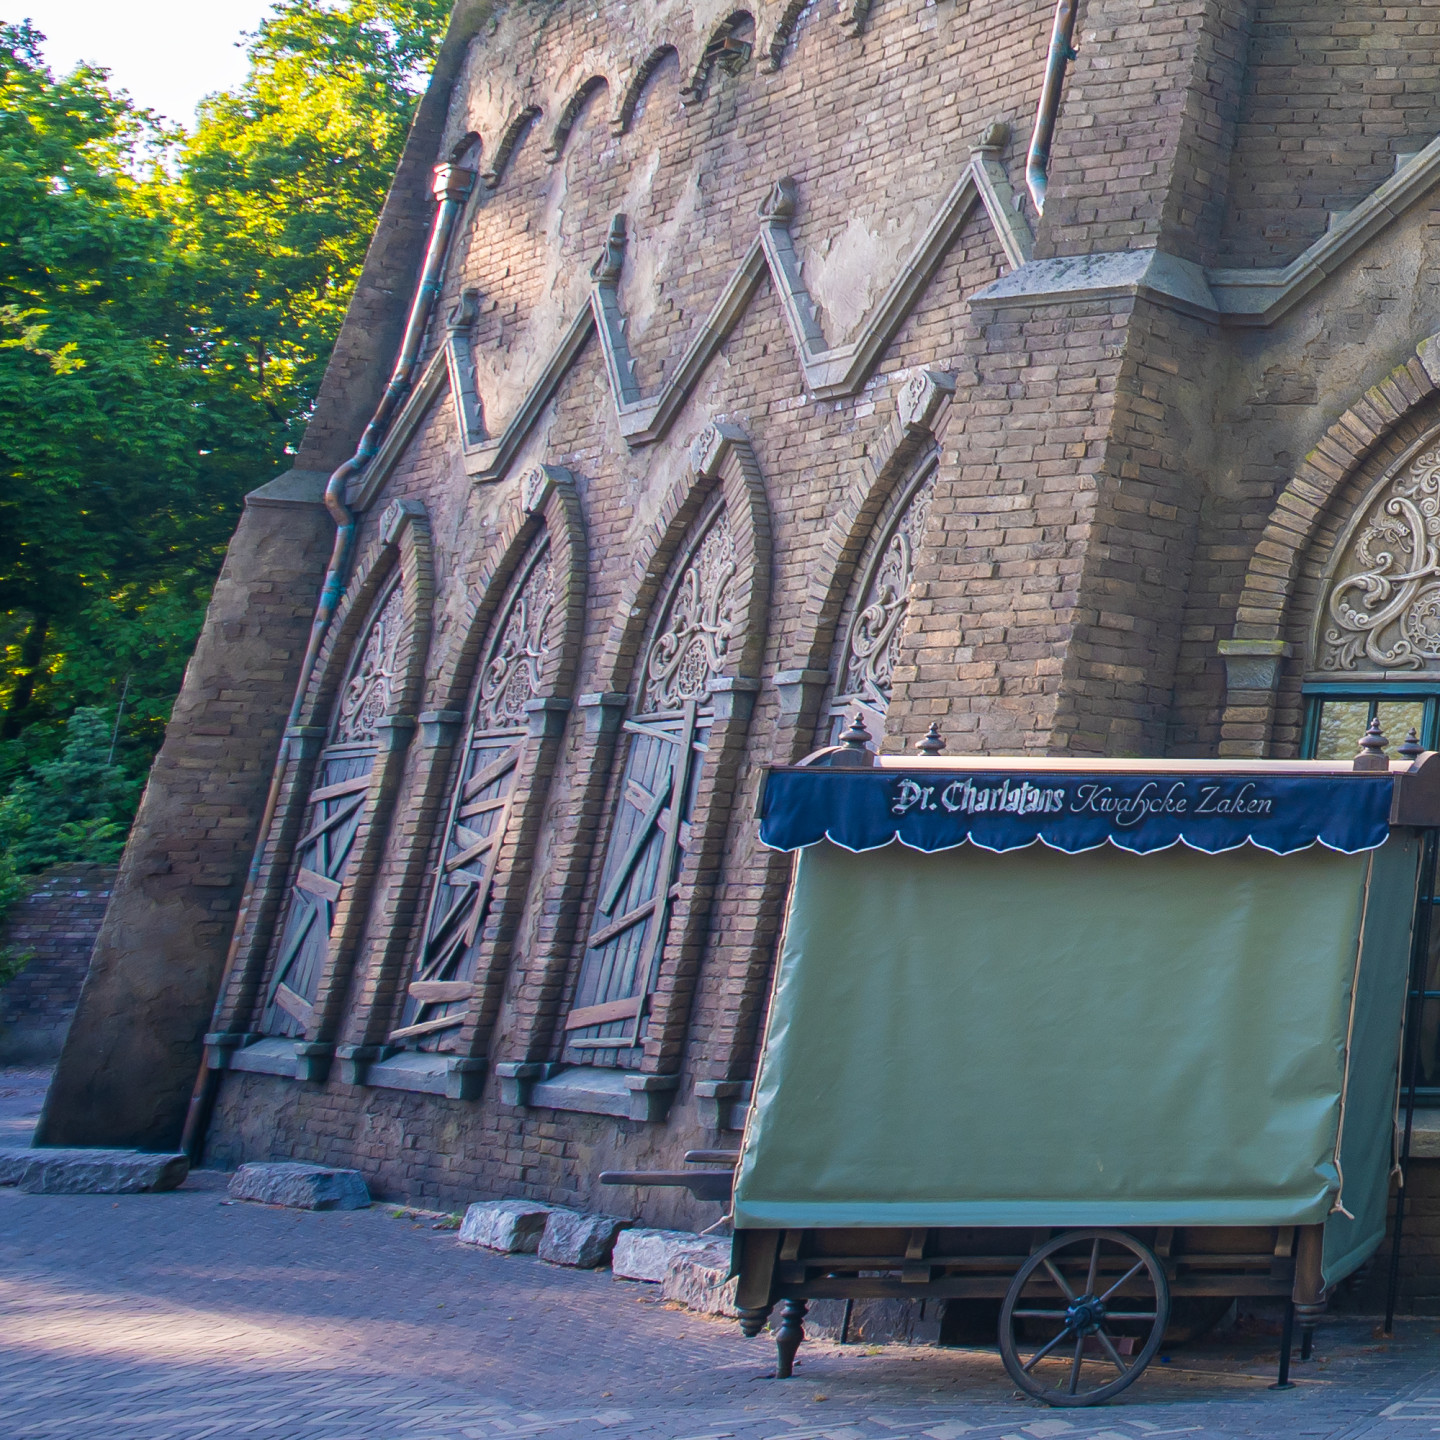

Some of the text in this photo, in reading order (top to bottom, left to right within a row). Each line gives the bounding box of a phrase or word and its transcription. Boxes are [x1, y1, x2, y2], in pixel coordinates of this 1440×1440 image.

[891, 778, 937, 815] Dr.
[941, 777, 1065, 816] Charlatans
[1194, 782, 1272, 813] Zaken
